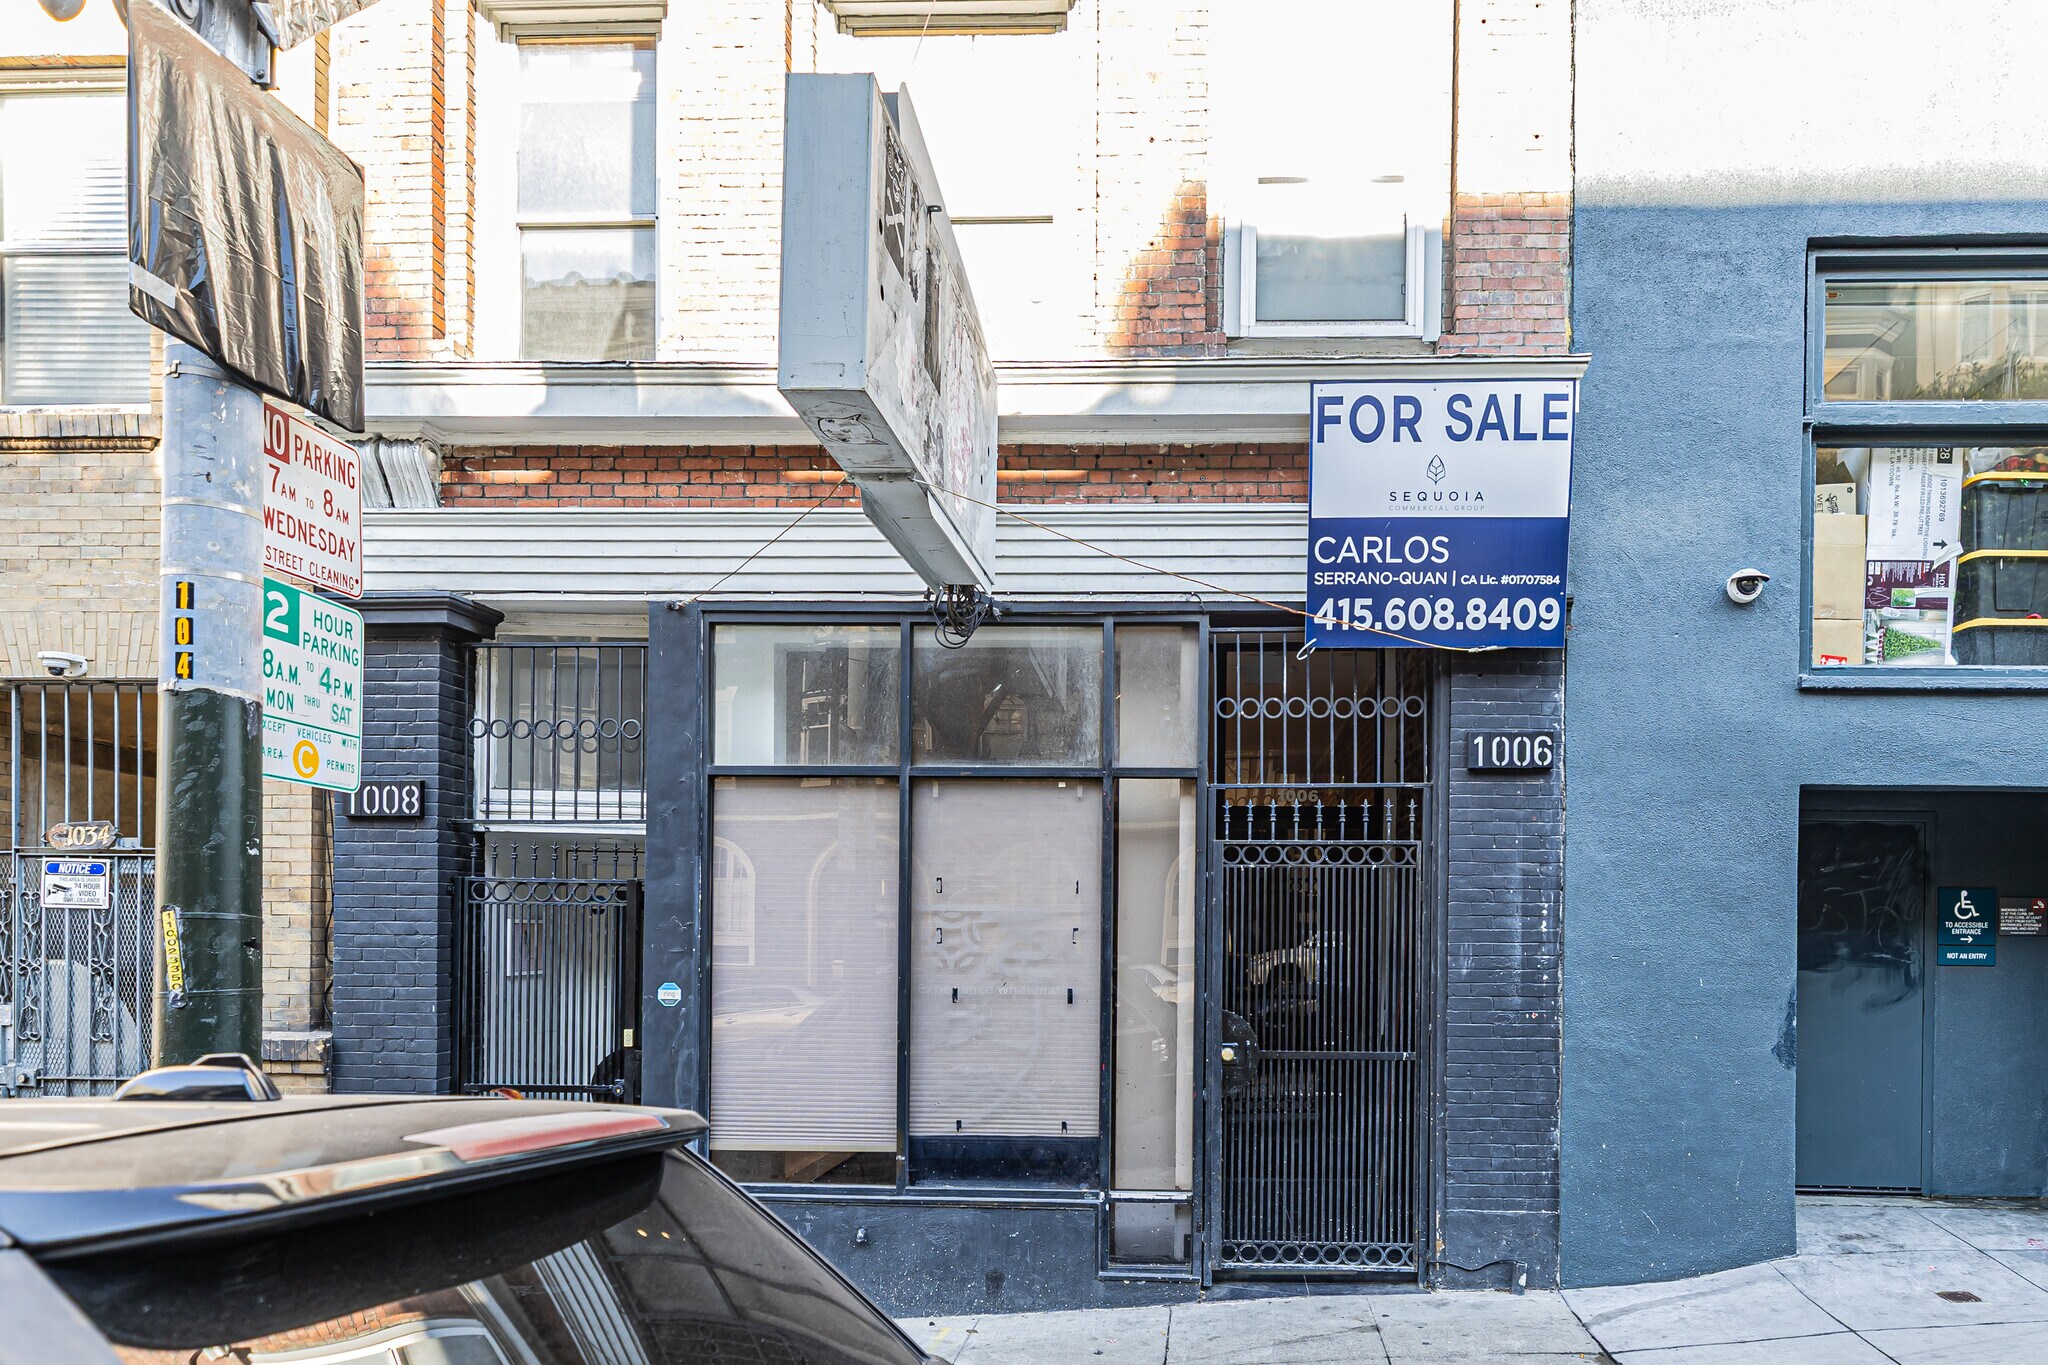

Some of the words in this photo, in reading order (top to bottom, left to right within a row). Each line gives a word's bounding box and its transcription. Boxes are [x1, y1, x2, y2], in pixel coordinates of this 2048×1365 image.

[1316, 394, 1423, 444] FOR
[1445, 393, 1569, 442] SALE
[294, 434, 356, 490] PARKING
[306, 498, 314, 510] TO
[1389, 491, 1484, 501] SEQUOIA
[1938, 478, 1947, 522] 1013692769
[264, 504, 355, 562] WEDNESDAY
[1314, 536, 1449, 564] CARLOS
[265, 546, 303, 572] STREET
[309, 561, 354, 590] CLEANING
[1314, 572, 1447, 585] SERRANO-QUAN
[1460, 575, 1477, 585] CA
[1501, 575, 1560, 585] #01707584
[266, 590, 289, 634] 2
[313, 609, 353, 640] HOUR
[1314, 597, 1560, 631] 415.608.8409
[177, 582, 189, 679] 104
[302, 631, 359, 667] PARKING
[306, 661, 314, 673] TO
[266, 687, 294, 712] MON
[304, 695, 321, 708] THRU
[331, 703, 352, 726] SAT
[262, 720, 286, 733] XCEPT
[296, 727, 332, 744] VEHICLES
[342, 738, 357, 750] WITH
[1473, 735, 1552, 767] 1006
[262, 746, 283, 760] AREA
[298, 746, 314, 774] C
[326, 759, 355, 774] PERMITS
[350, 785, 419, 814] 1008
[67, 825, 110, 846] 1034
[58, 863, 92, 874] NOTICE
